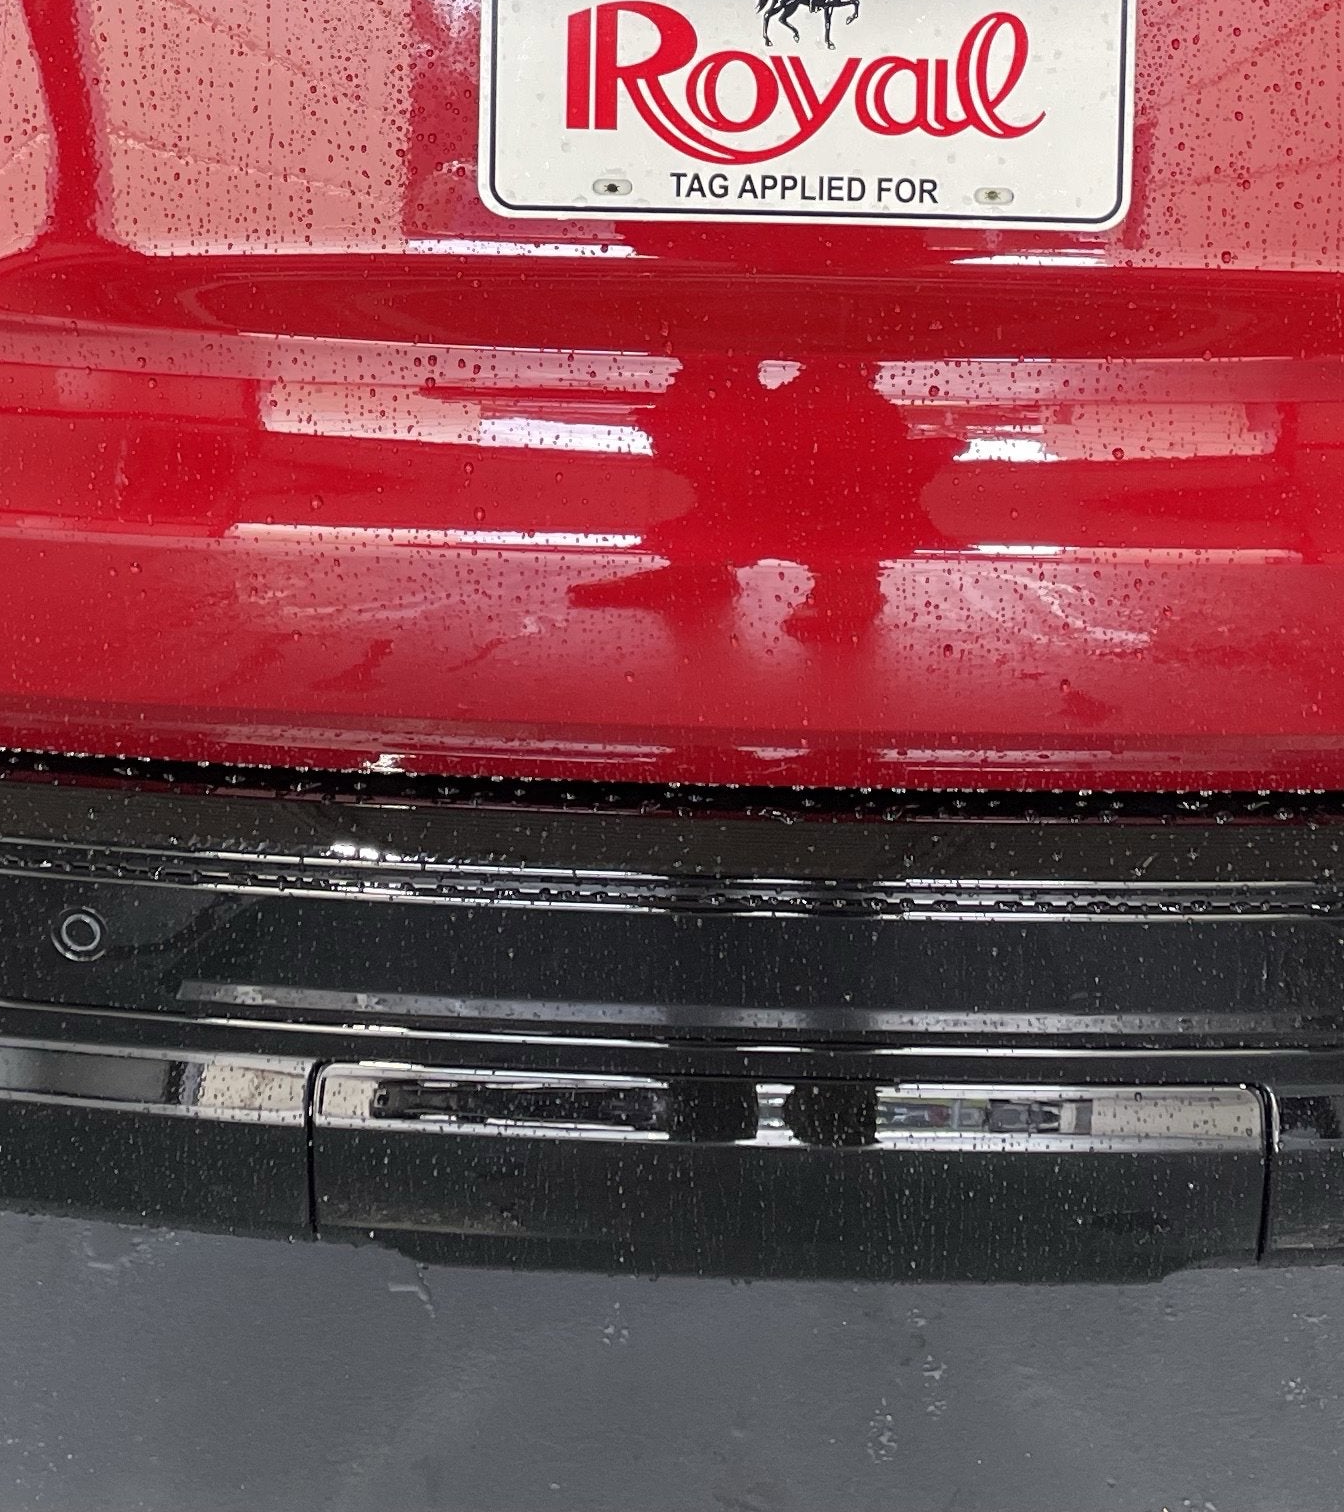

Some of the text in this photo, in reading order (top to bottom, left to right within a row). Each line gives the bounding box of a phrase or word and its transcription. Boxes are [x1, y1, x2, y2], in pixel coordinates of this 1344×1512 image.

[565, 0, 1047, 165] Royal
[669, 172, 938, 204] TAG APPLIED FOR
